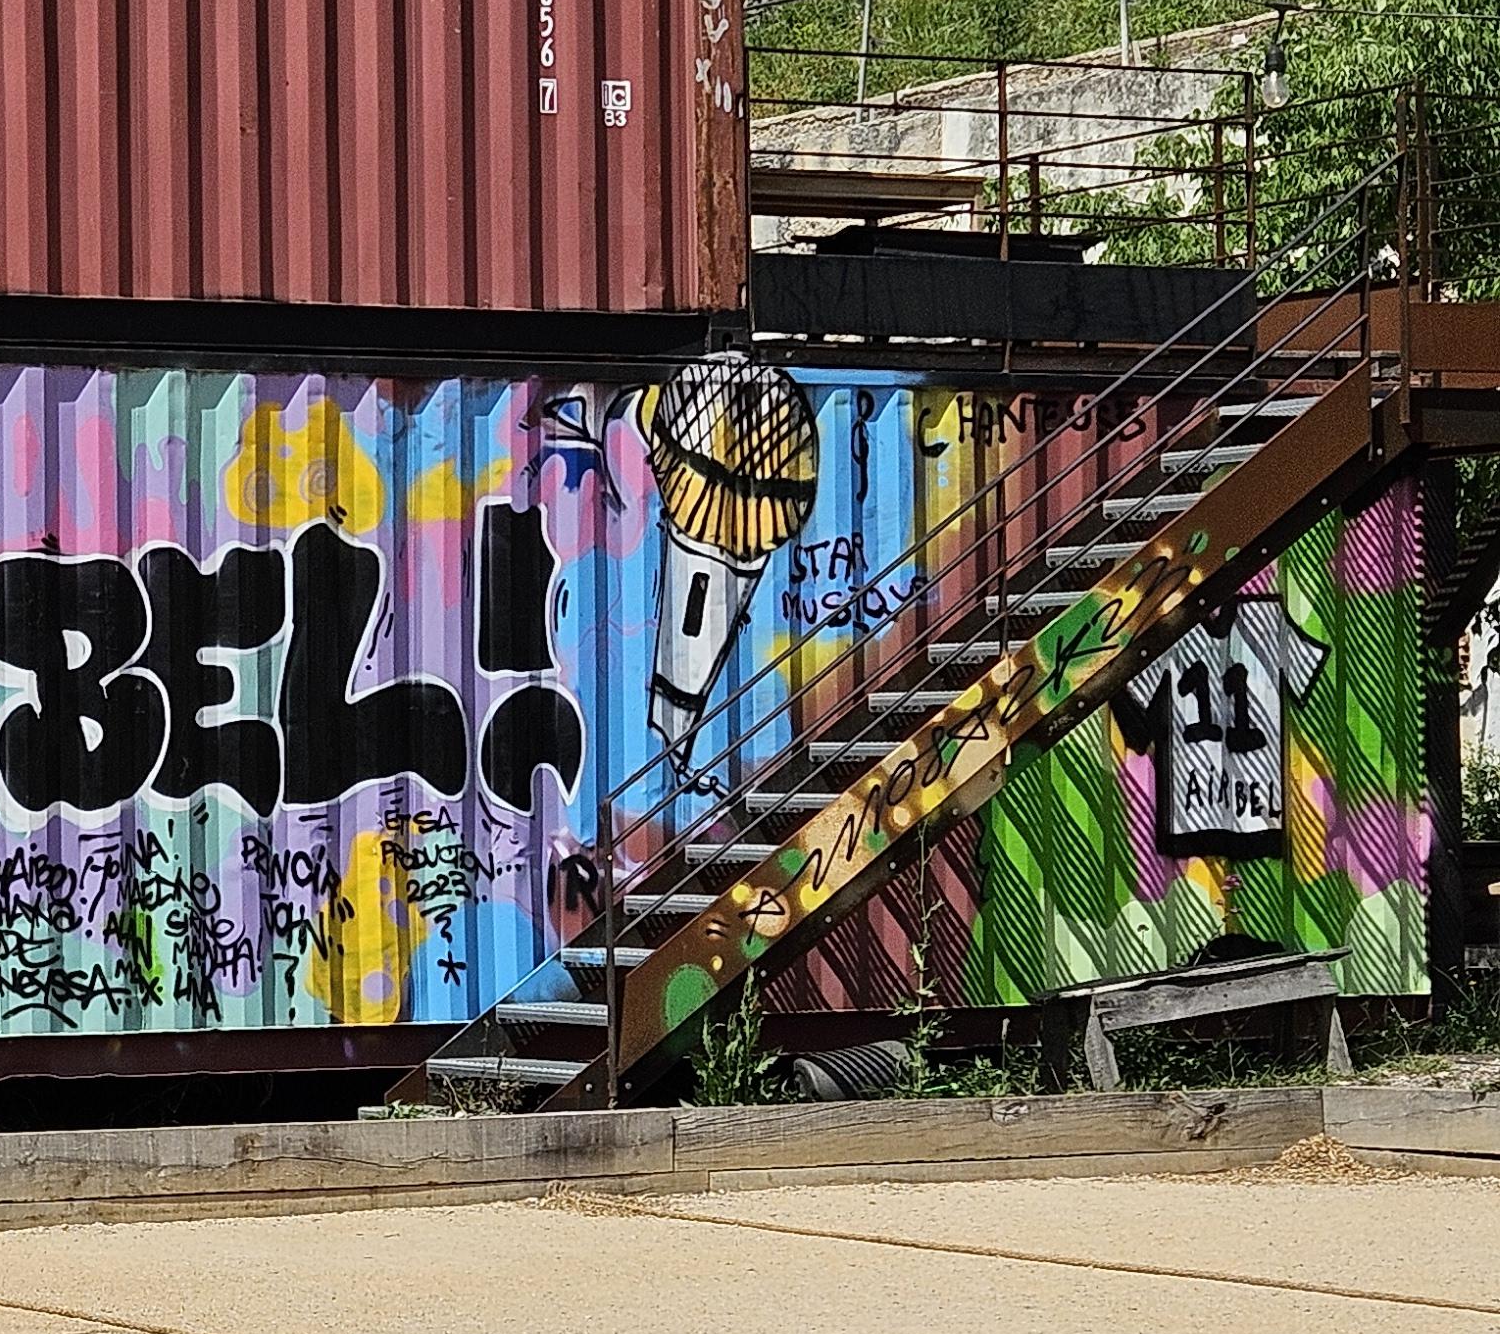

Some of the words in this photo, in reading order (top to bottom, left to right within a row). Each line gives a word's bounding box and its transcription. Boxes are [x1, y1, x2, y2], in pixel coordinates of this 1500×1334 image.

[539, 78, 558, 113] 7
[603, 109, 628, 128] 83
[789, 531, 869, 584] STAR
[1177, 659, 1268, 754] 11
